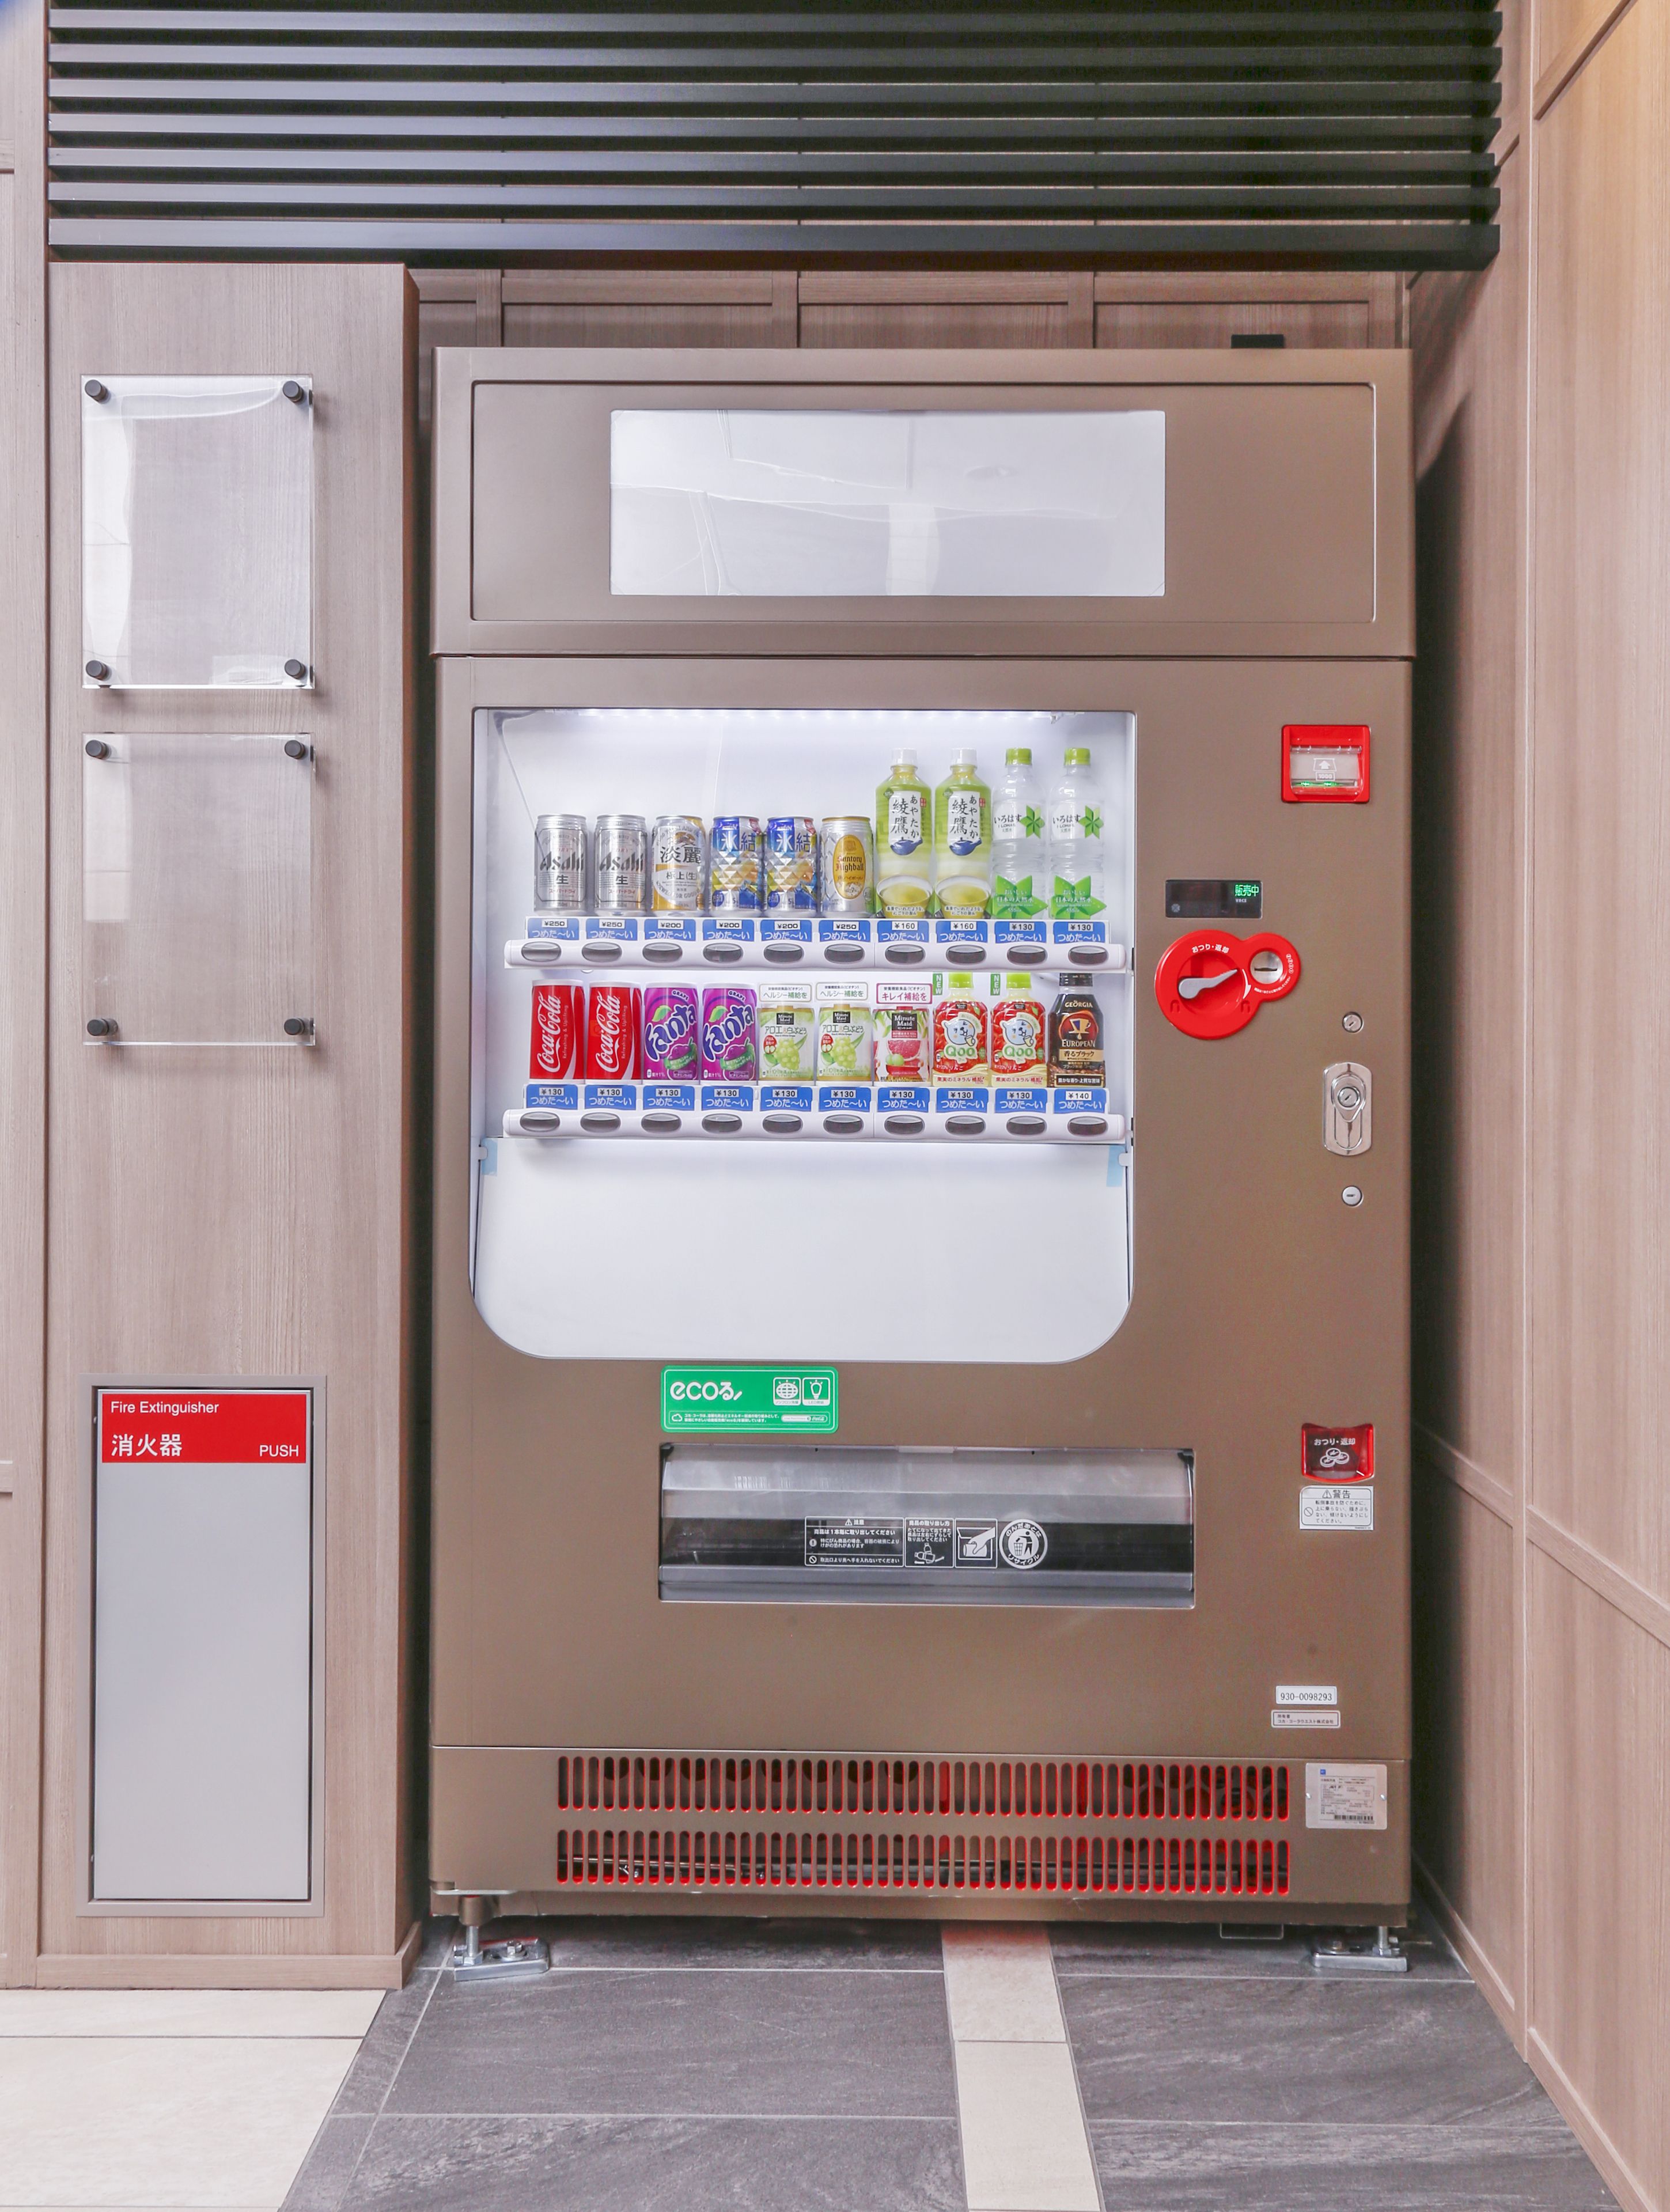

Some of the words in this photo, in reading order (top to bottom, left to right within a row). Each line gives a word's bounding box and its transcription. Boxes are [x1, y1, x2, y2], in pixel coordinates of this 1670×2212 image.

[891, 798, 910, 835] 綾鷹
[910, 795, 919, 839] あやたか
[949, 798, 969, 835] 綾鷹
[969, 795, 978, 839] あやたか
[994, 813, 1022, 824] いろはす
[1052, 814, 1081, 824] いろはす
[721, 831, 756, 852] 氷結
[776, 832, 811, 853] 氷結
[660, 846, 702, 863] 淡麗
[837, 855, 863, 863] Suntory
[540, 851, 584, 871] Asahi
[600, 852, 643, 872] Asahi
[836, 862, 864, 873] Highball
[556, 874, 569, 884] 生
[616, 875, 628, 885] 生
[1234, 884, 1259, 896] 販売中
[1192, 944, 1230, 954] おつり・返却
[672, 990, 688, 1001] GRAPE
[728, 991, 745, 1002] GRAPE
[882, 993, 927, 1001] キレイ補給を
[645, 1004, 697, 1062] Fanta
[702, 1005, 753, 1062] Fanta
[945, 1046, 975, 1057] Qoo
[1004, 1046, 1033, 1058] Qoo
[111, 1402, 135, 1413] Fire
[140, 1401, 219, 1416] Extinguisher
[111, 1434, 183, 1457] 消火器
[1314, 1437, 1355, 1446] おつり・返却
[259, 1445, 300, 1457] PUSH
[1333, 1490, 1350, 1498] 警告
[1006, 1522, 1042, 1538] のんだあとは
[1008, 1554, 1040, 1566] リサイクル
[1280, 1692, 1332, 1700] 930-0098293
